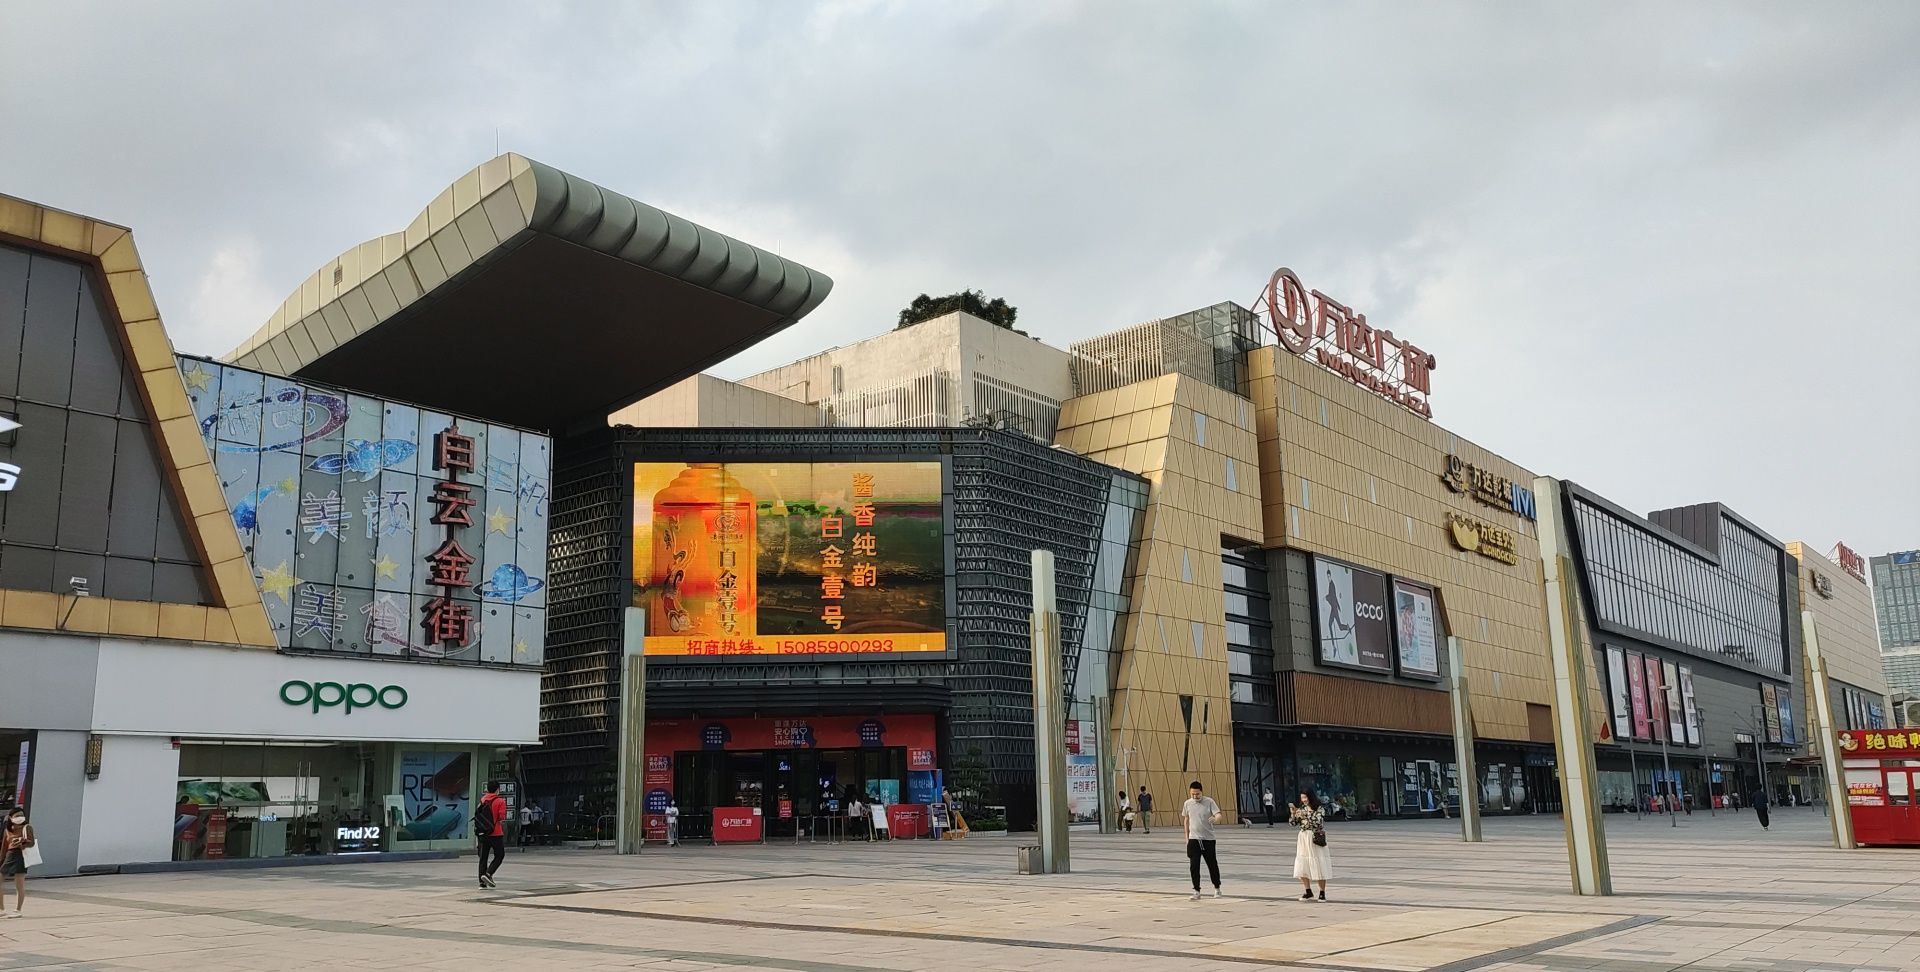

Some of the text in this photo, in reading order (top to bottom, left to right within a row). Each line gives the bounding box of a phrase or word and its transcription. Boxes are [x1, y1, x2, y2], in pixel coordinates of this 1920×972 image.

[1311, 288, 1431, 395] 万达广场
[1315, 347, 1433, 418] WANDA PLAZA
[301, 488, 413, 544] 美颜
[424, 425, 477, 647] 白云金街
[851, 472, 877, 588] 酱香纯韵
[716, 548, 738, 635] 白金壹号
[820, 514, 847, 631] 白金壹号
[294, 584, 438, 652] 美食
[1355, 602, 1384, 621] ecco
[775, 639, 894, 654] 15085900293
[280, 680, 408, 715] oppo
[337, 826, 380, 840] Find X2
